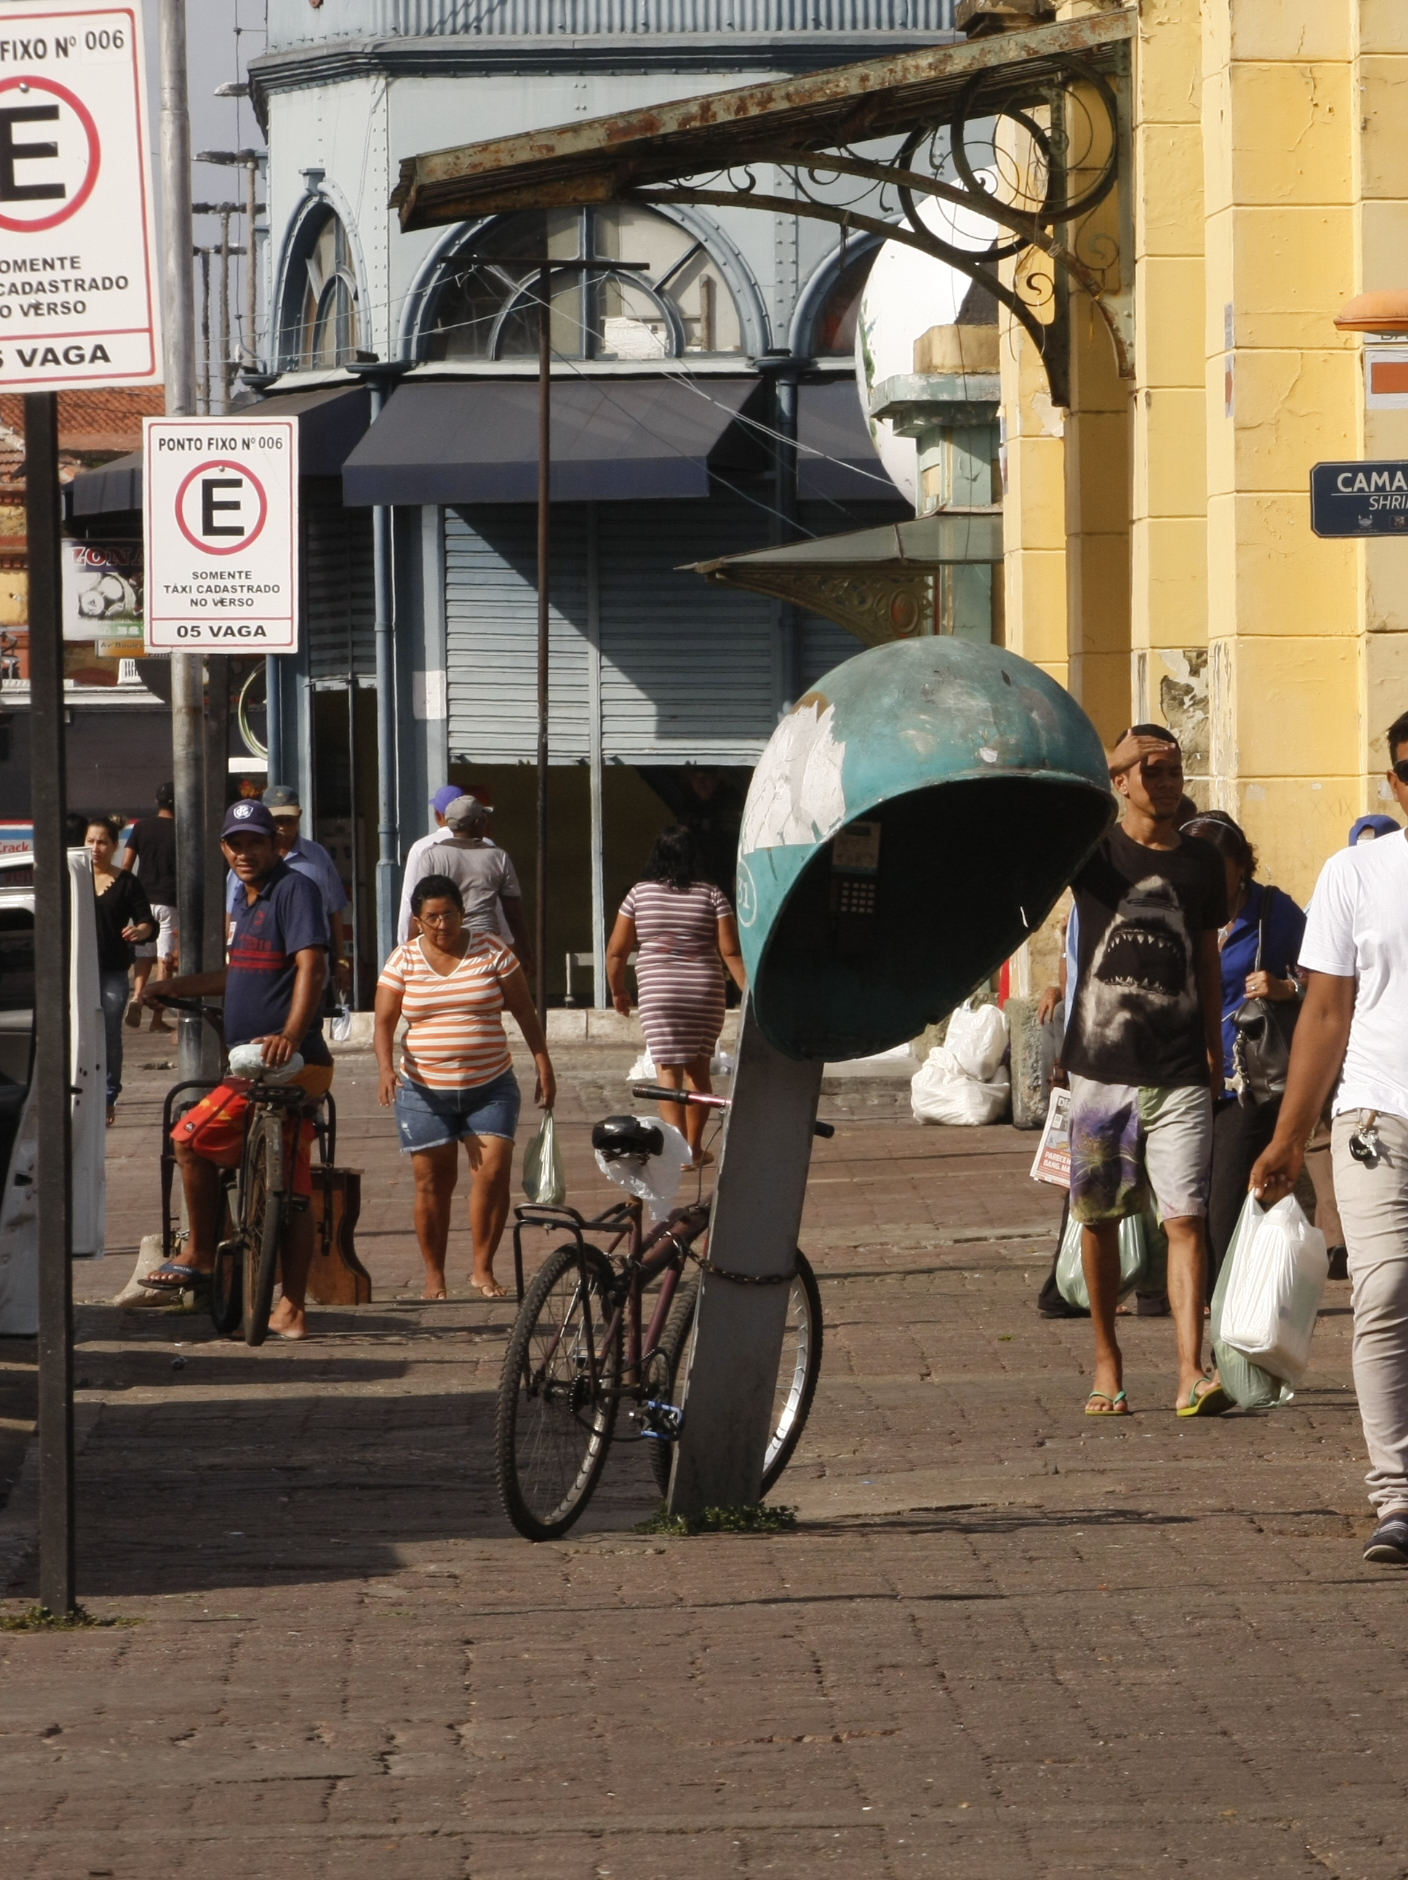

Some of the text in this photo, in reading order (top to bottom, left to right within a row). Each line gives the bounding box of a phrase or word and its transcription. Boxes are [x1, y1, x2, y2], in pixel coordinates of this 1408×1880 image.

[0, 37, 48, 61] FIXO
[85, 29, 125, 50] 006
[0, 104, 66, 202] E
[19, 300, 87, 318] VERSO
[15, 343, 112, 368] VAGA
[159, 437, 203, 451] PONTO
[207, 437, 237, 450] FIXO
[258, 436, 283, 449] 006
[202, 478, 245, 536] E
[192, 570, 252, 580] SOMENTE
[163, 583, 281, 594] TÁXI CADASTRADO
[190, 597, 255, 608] NO VERSO
[176, 625, 268, 638] 05 VAGA
